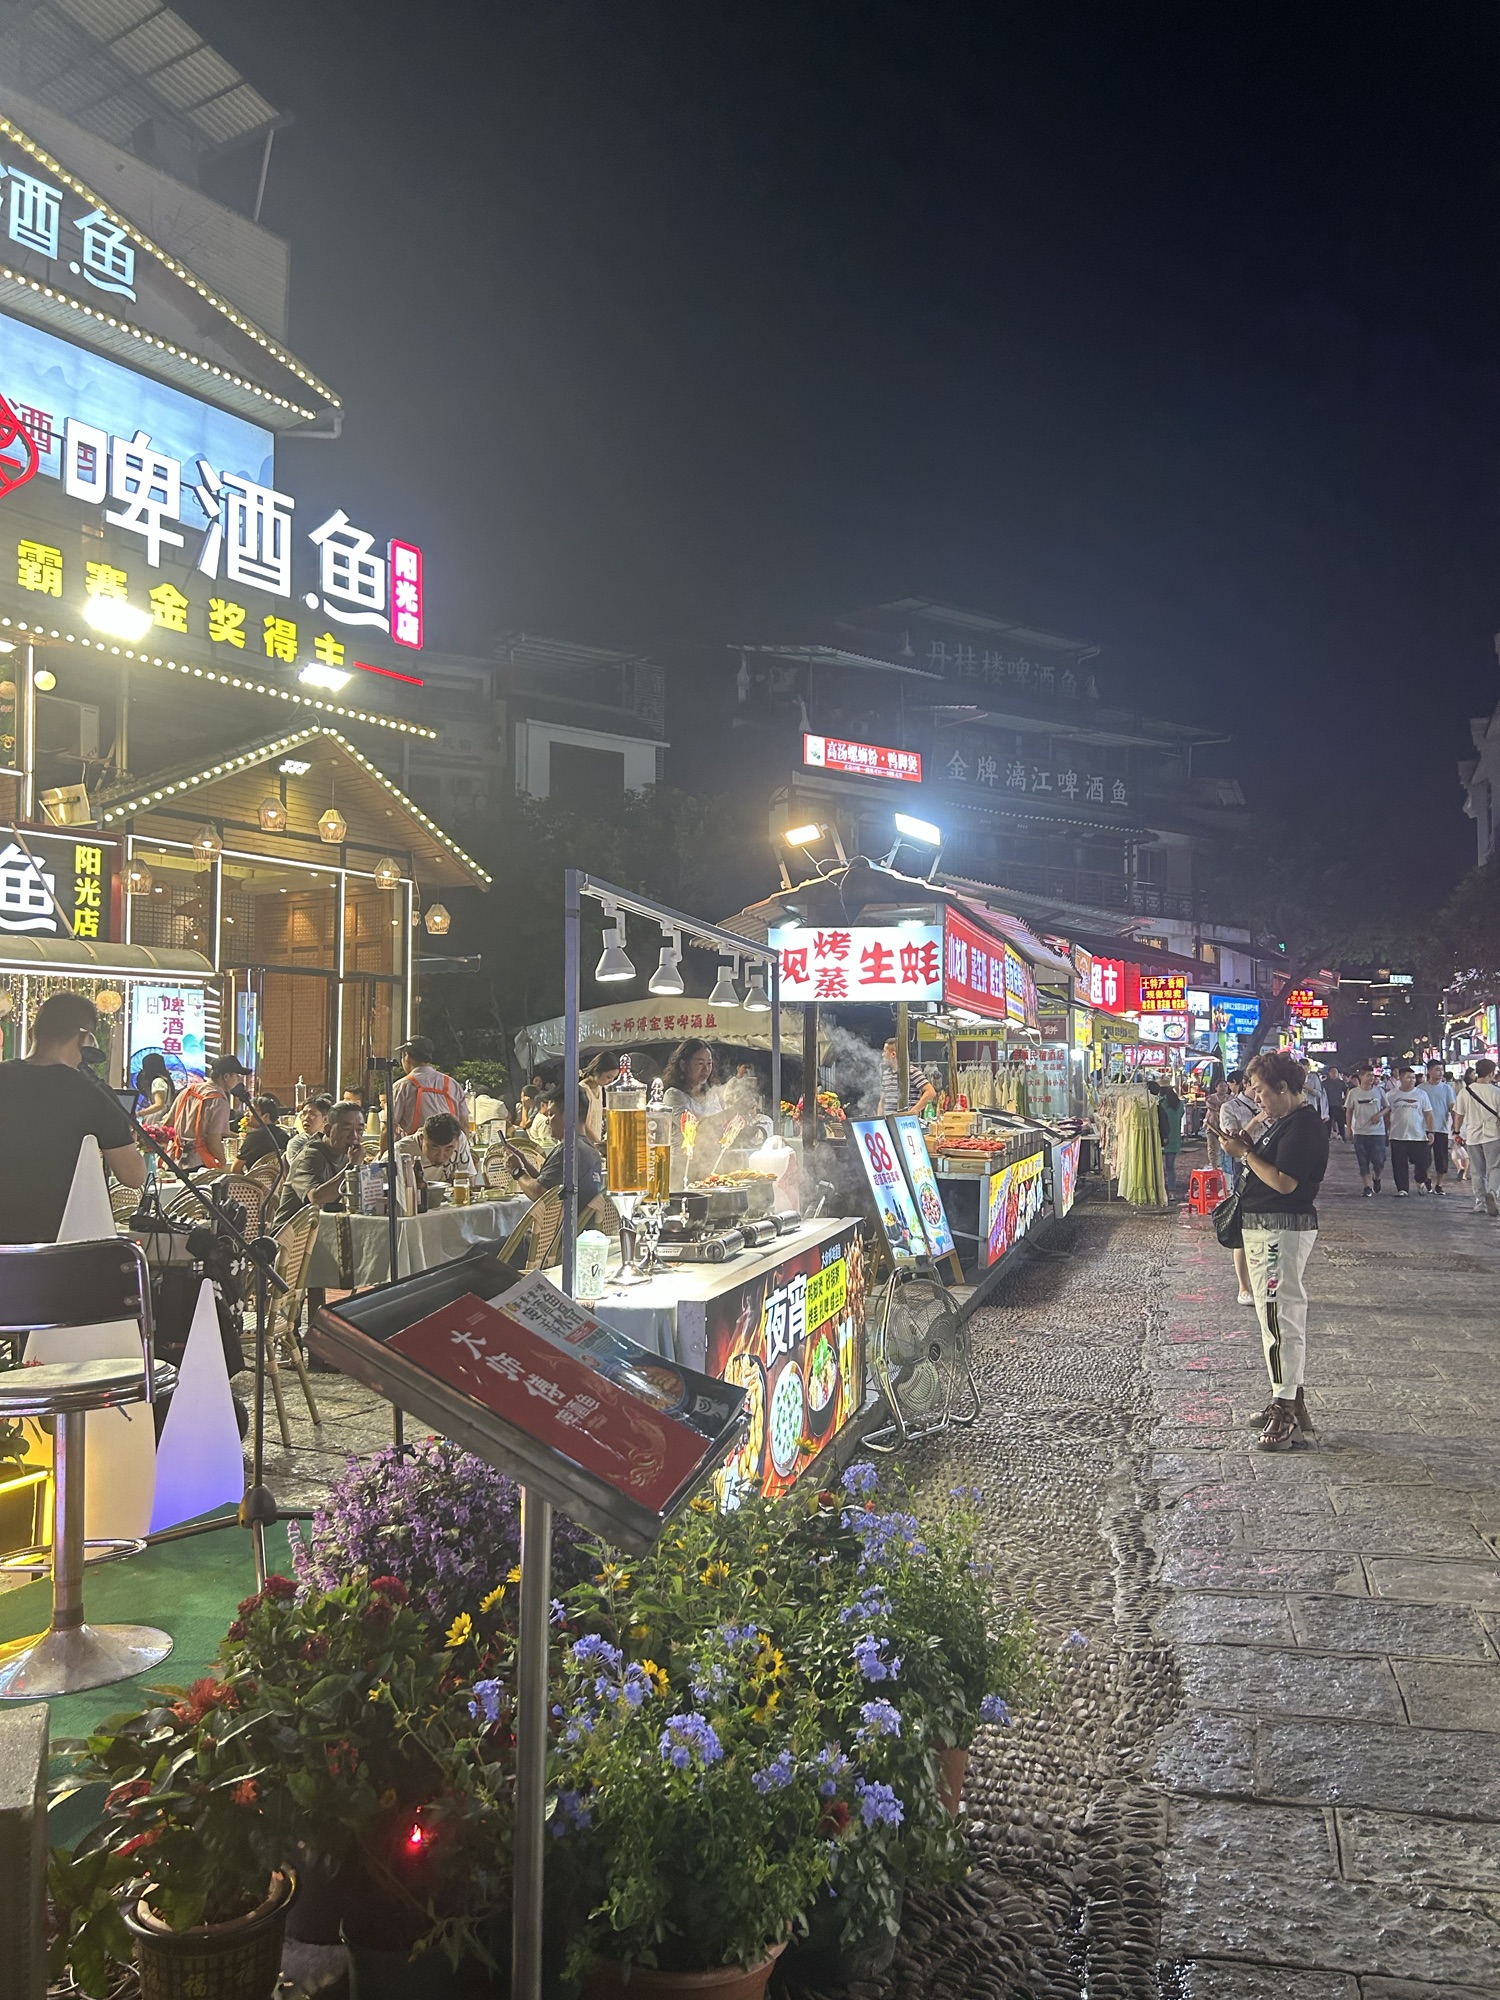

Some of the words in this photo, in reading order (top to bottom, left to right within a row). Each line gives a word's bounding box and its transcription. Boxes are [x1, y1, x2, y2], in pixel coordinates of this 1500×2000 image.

[63, 416, 390, 632] 啤酒鱼
[395, 546, 419, 645] 阳光店
[926, 640, 1077, 698] 丹桂楼啤酒鱼
[946, 750, 1129, 806] 金牌漓江啤酒鱼
[0, 842, 57, 932] 鱼
[74, 845, 101, 937] 阳光店
[814, 966, 849, 998] 蒸
[858, 940, 940, 985] 生蚝
[1090, 961, 1118, 1006] 超市
[1142, 978, 1166, 989] 土特产
[162, 995, 185, 1055] 啤酒鱼
[611, 1013, 717, 1032] 大师傅金奖啤酒鱼
[864, 1132, 893, 1172] 88
[765, 1273, 807, 1368] 夜宵
